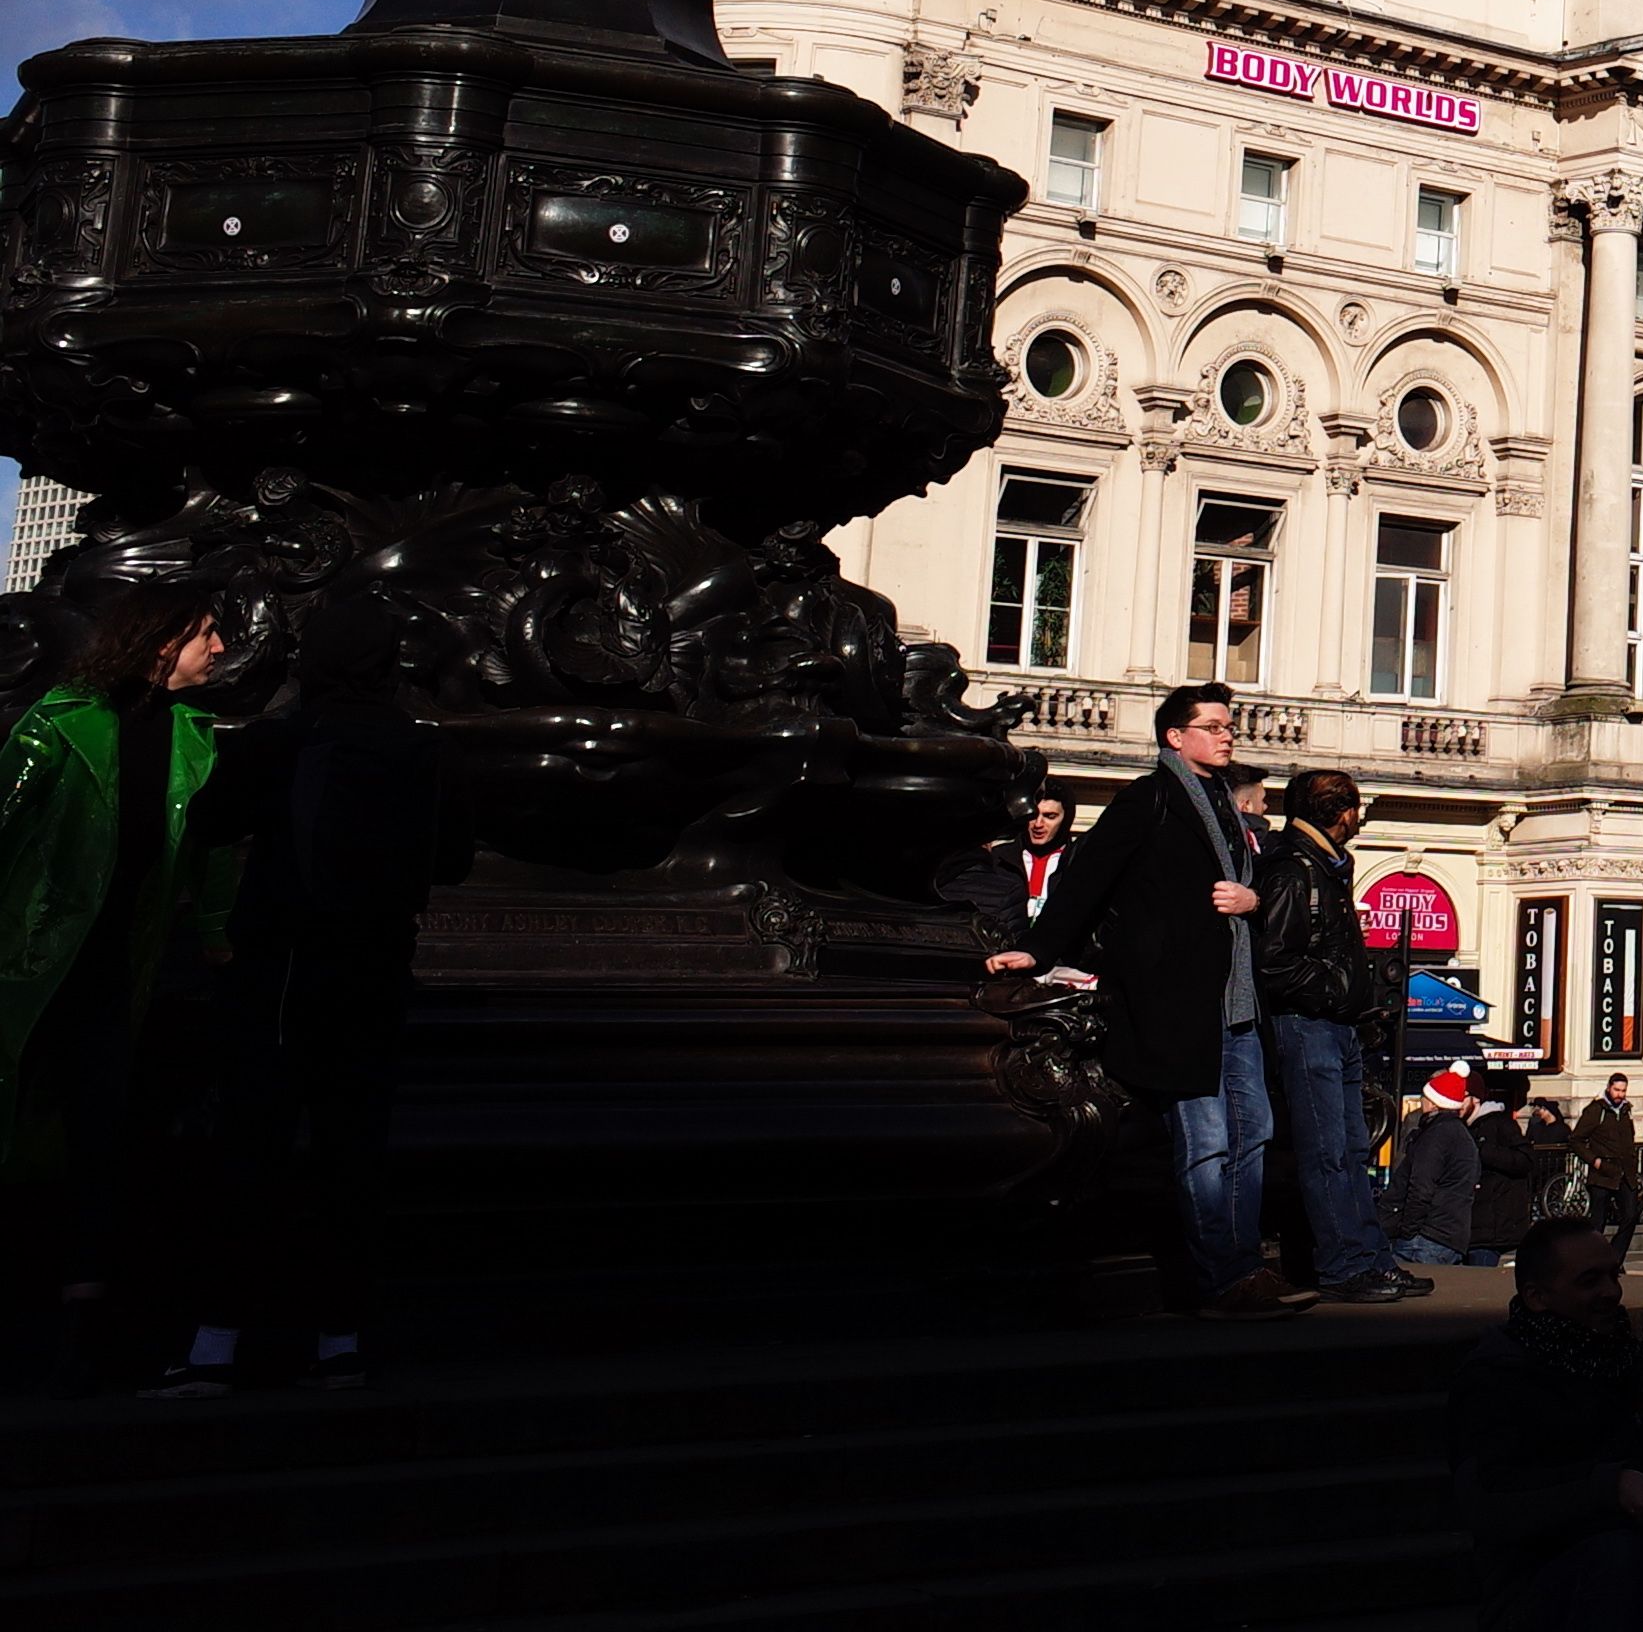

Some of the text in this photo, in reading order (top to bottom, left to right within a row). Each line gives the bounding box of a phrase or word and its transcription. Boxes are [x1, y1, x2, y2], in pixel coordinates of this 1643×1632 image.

[1205, 41, 1481, 136] BODY WORLDS
[1380, 892, 1436, 911] BODY
[1523, 908, 1539, 1049] TOBACC
[1602, 920, 1615, 1052] TOBACCO
